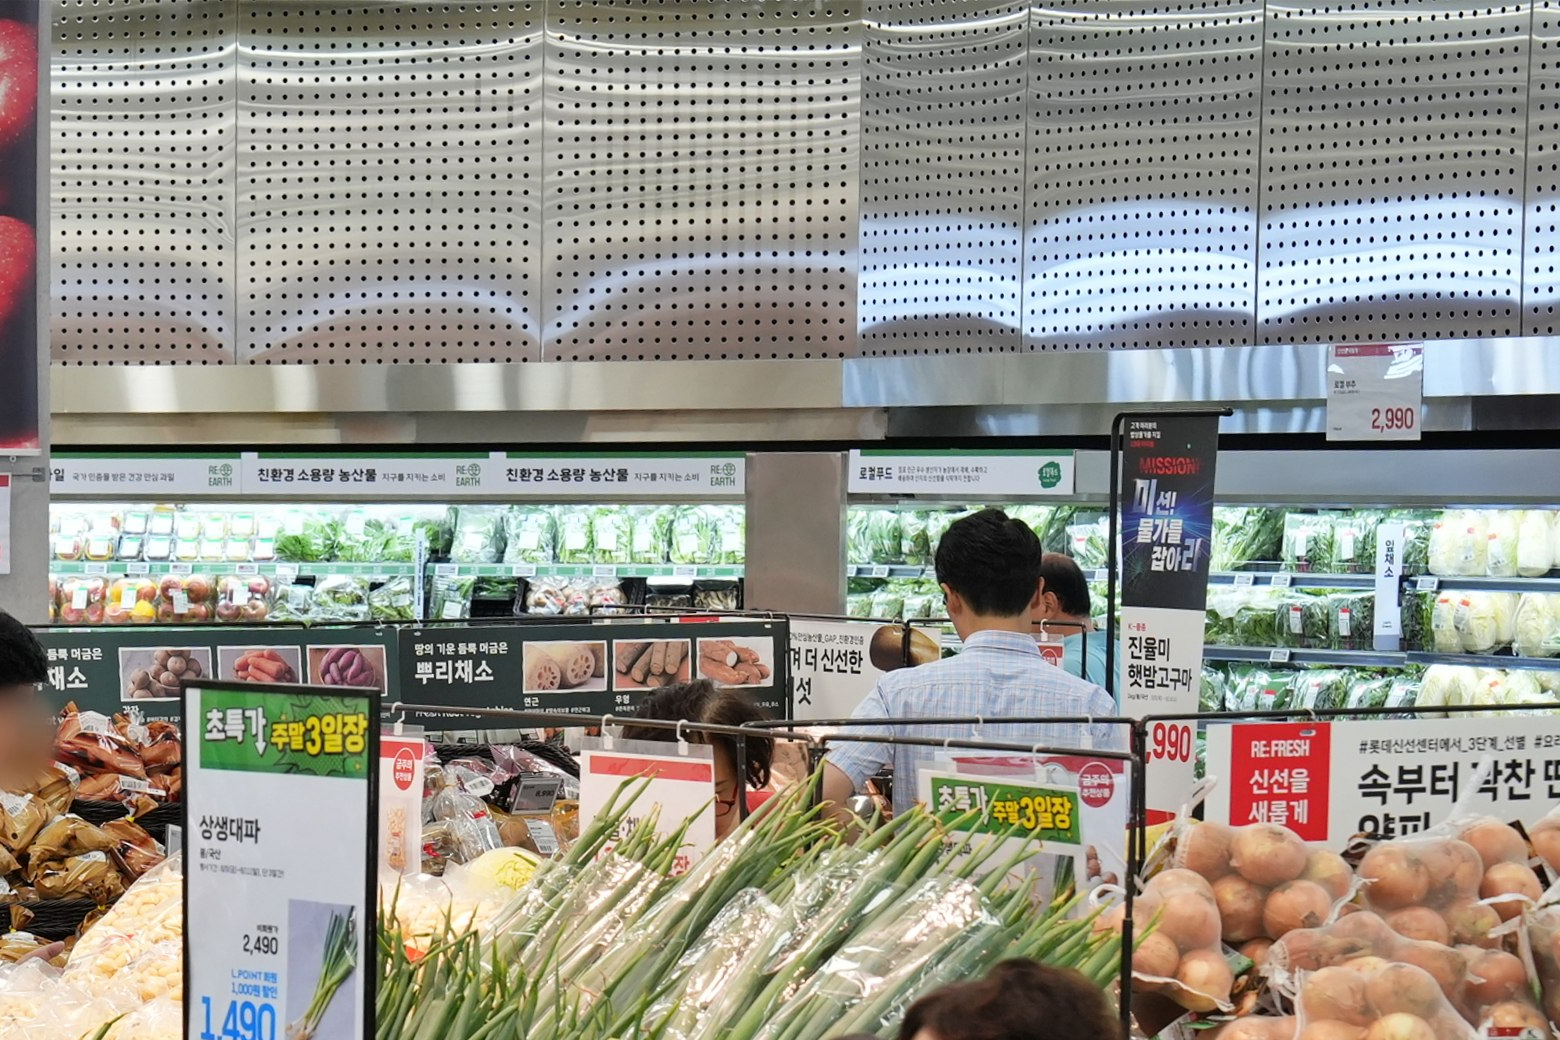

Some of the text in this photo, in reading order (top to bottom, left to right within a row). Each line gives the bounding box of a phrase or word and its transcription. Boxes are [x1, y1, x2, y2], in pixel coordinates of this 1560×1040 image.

[1371, 407, 1415, 433] 2,990
[209, 477, 233, 487] EARTH
[257, 467, 294, 483] 친환경
[297, 467, 336, 483] 소용량
[338, 467, 378, 483] 농산물
[456, 477, 481, 487] EARTH
[506, 467, 544, 483] 친환경
[547, 467, 587, 483] 소용량
[589, 467, 630, 483] 농산물
[710, 477, 736, 487] EARTH
[858, 466, 893, 481] 로컬푸드
[1132, 479, 1177, 516] 미션!
[1136, 517, 1184, 544] 물가를
[1151, 537, 1203, 572] 잡아라
[71, 647, 103, 661] 머금은
[436, 642, 456, 656] 기운
[479, 641, 509, 655] 머금은
[805, 648, 864, 675] 더 신선한
[1128, 635, 1170, 662] 진율미
[46, 665, 89, 691] 채소
[414, 659, 495, 685] 뿌리채소
[1127, 664, 1193, 693] 햇밤고구마
[524, 696, 541, 708] 연근
[615, 694, 630, 705] 우엉
[205, 706, 268, 757] 초특가
[1146, 722, 1192, 764] ,990
[1250, 739, 1311, 760] RE:FRESH
[1249, 768, 1311, 797] 신선을
[1358, 759, 1462, 806] 속부터
[1248, 799, 1310, 827] 새롭게
[199, 814, 262, 845] 상생대파
[243, 934, 279, 956] 2,490
[231, 968, 263, 982] L.POINT
[231, 982, 261, 998] 1,000원
